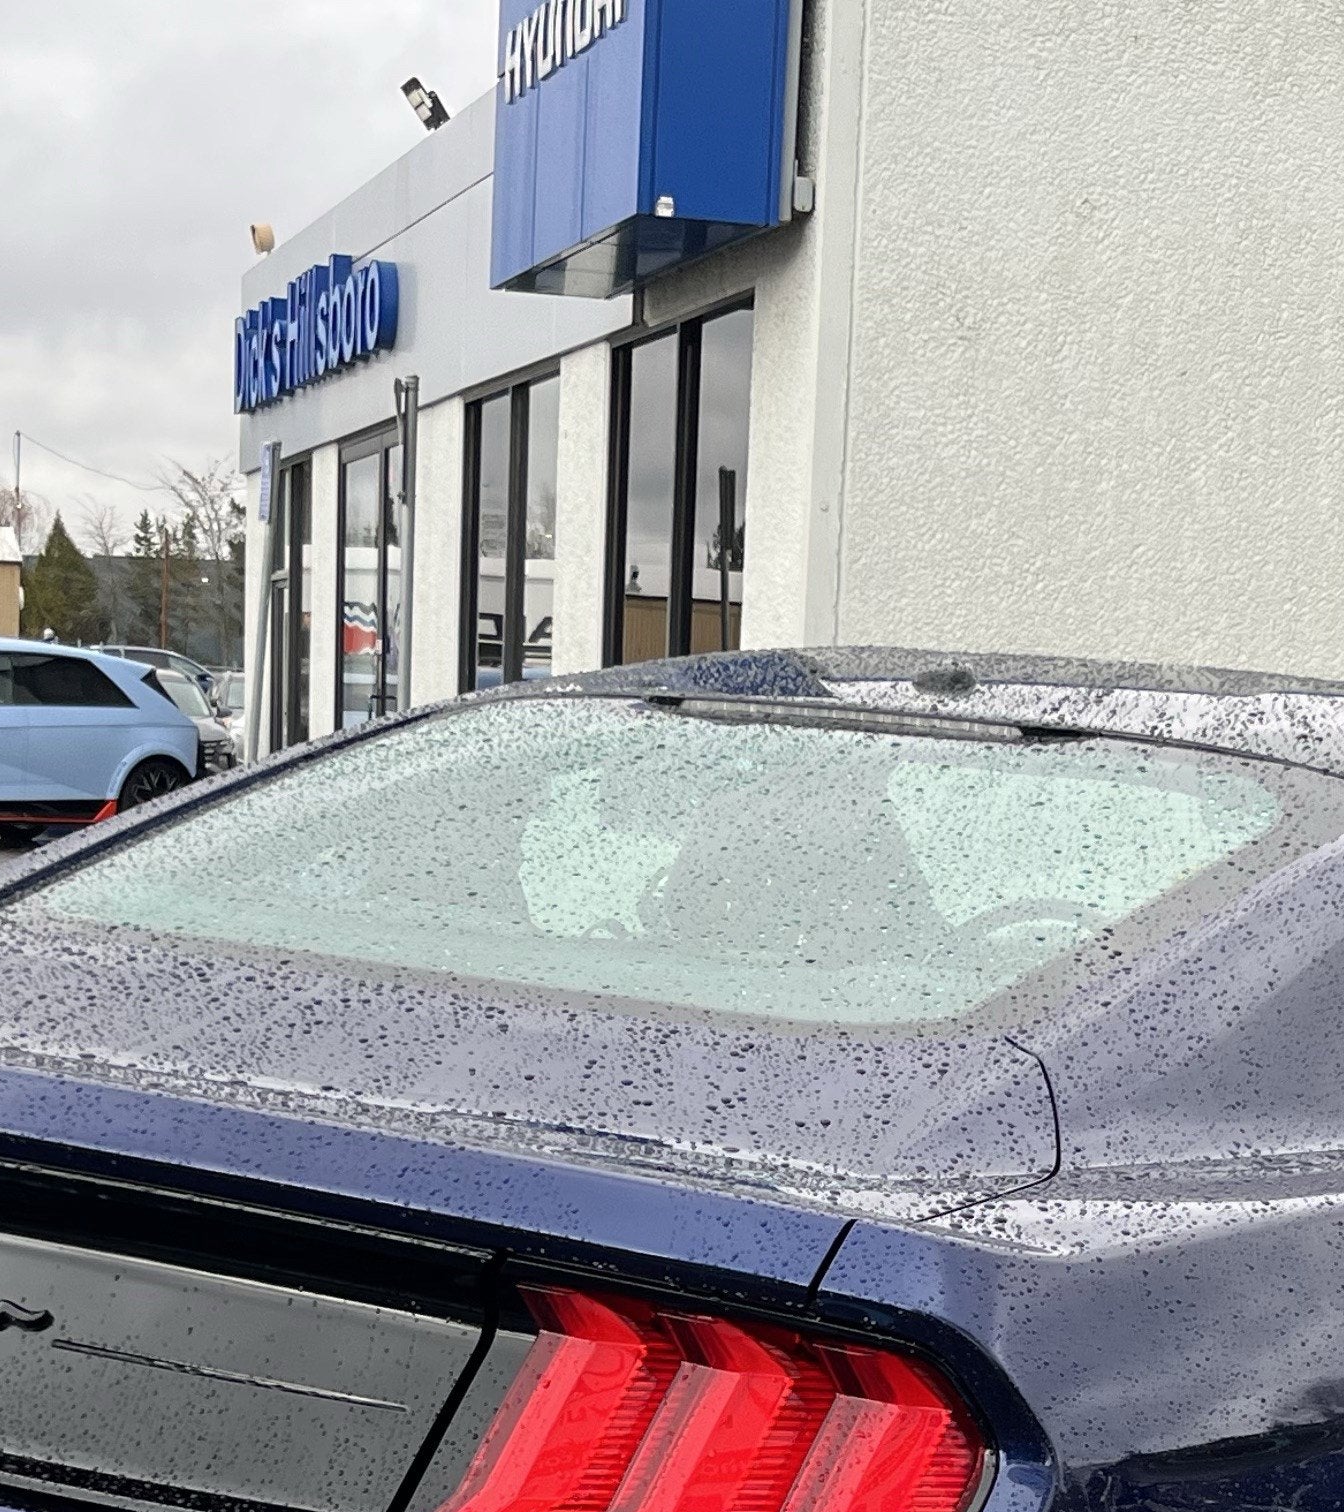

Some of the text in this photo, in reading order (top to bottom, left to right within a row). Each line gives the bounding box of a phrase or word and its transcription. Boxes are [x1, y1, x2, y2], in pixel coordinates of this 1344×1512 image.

[504, 0, 624, 104] HYUND
[234, 254, 382, 414] Dick's Hillsboro
